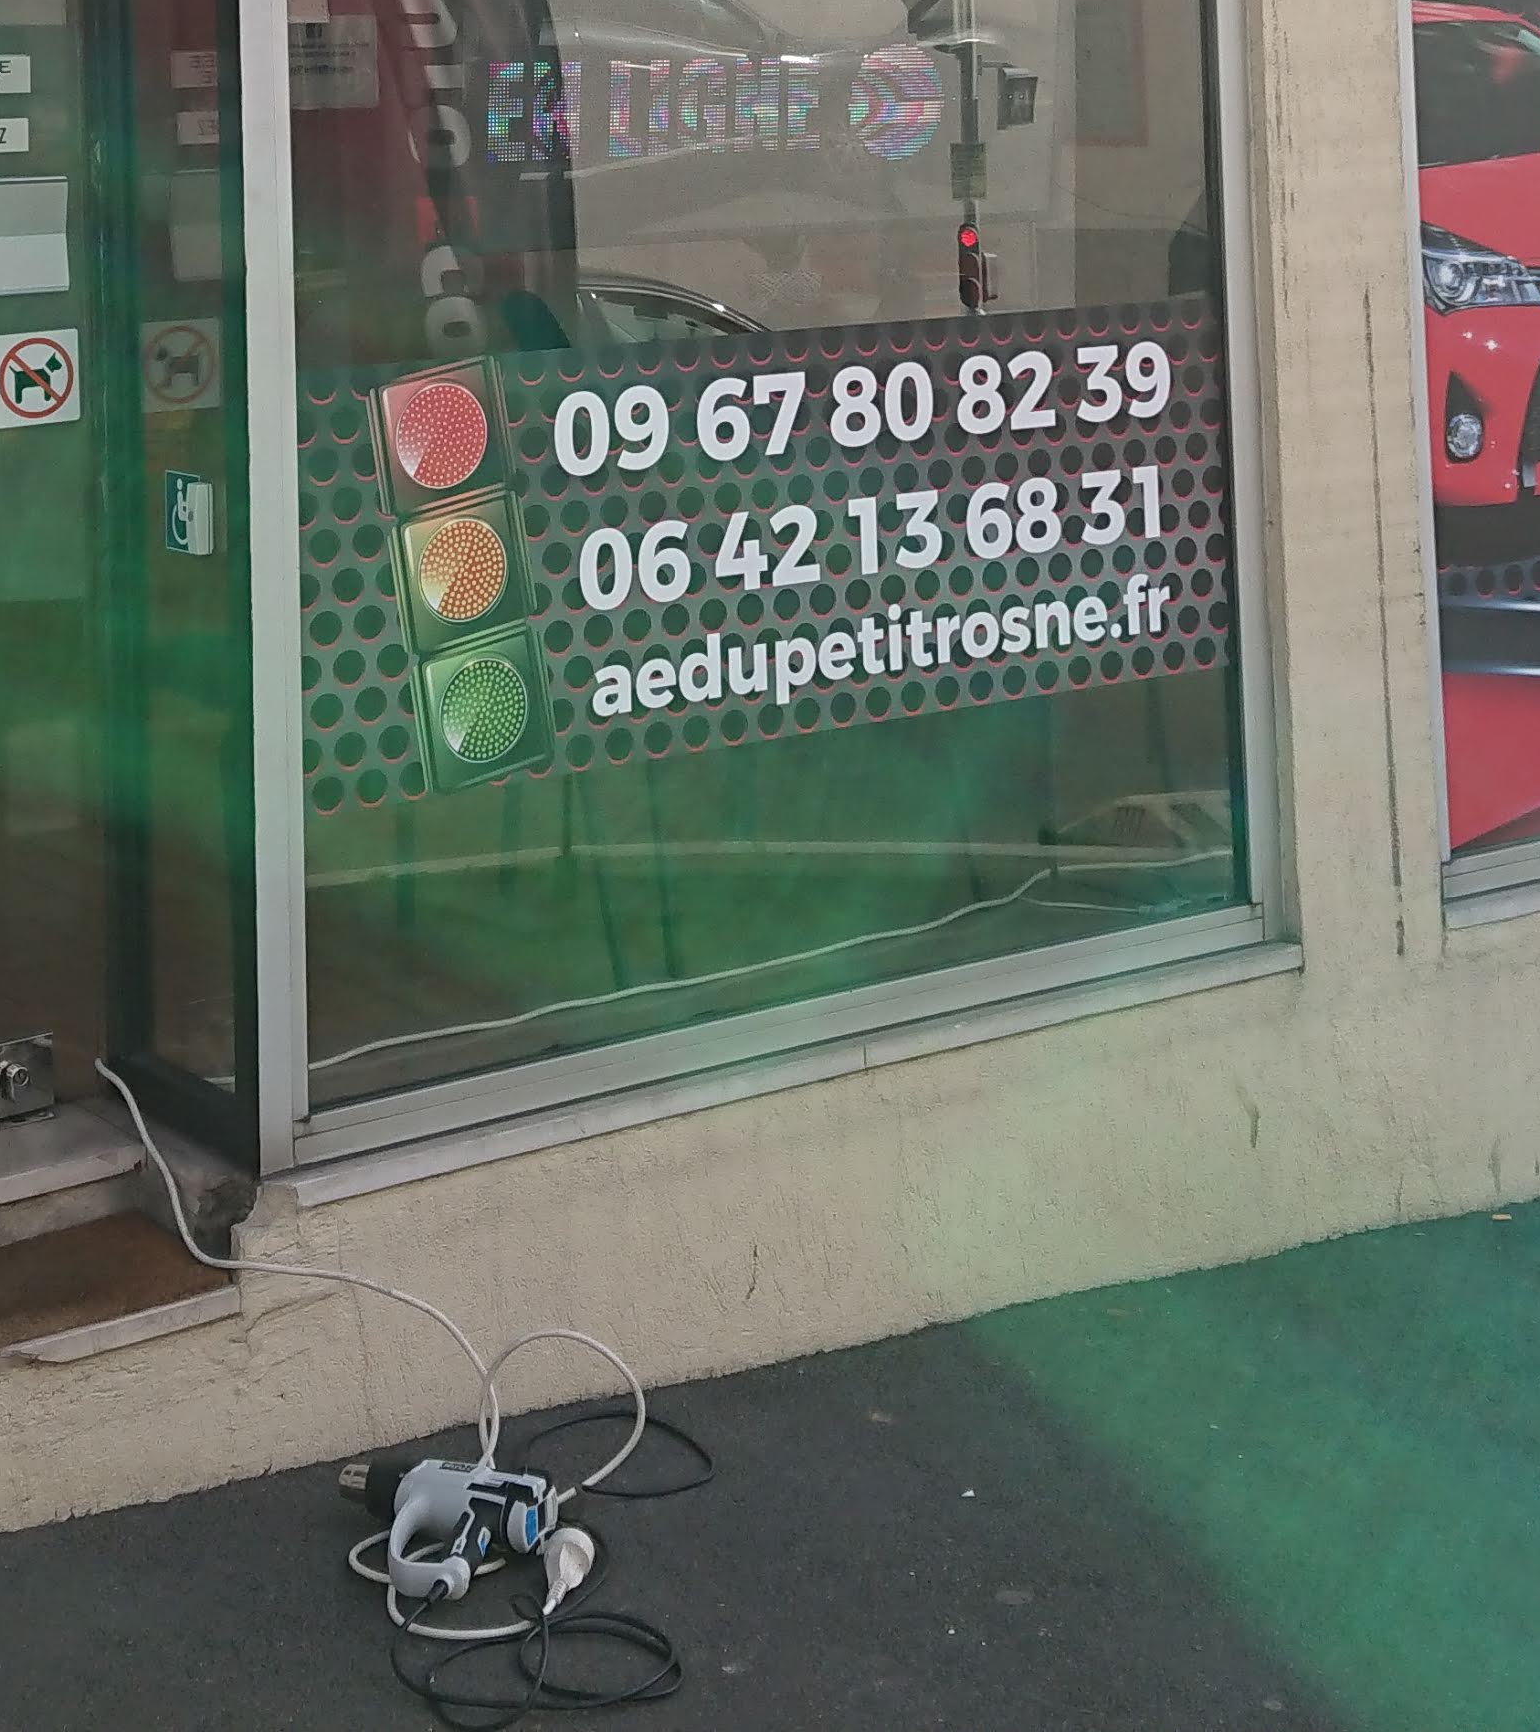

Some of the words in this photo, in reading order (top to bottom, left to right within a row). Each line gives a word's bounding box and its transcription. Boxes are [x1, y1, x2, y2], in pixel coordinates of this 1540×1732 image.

[554, 385, 669, 477] 09
[696, 372, 806, 461] 67
[831, 361, 933, 448] 80
[957, 351, 1056, 436] 82
[1077, 341, 1172, 424] 39
[580, 520, 691, 611] 06
[715, 504, 821, 591] 42
[848, 490, 942, 575] 13
[966, 477, 1061, 561] 68
[1080, 465, 1162, 547] 31
[592, 575, 1172, 718] aedupetitrosne.fr
